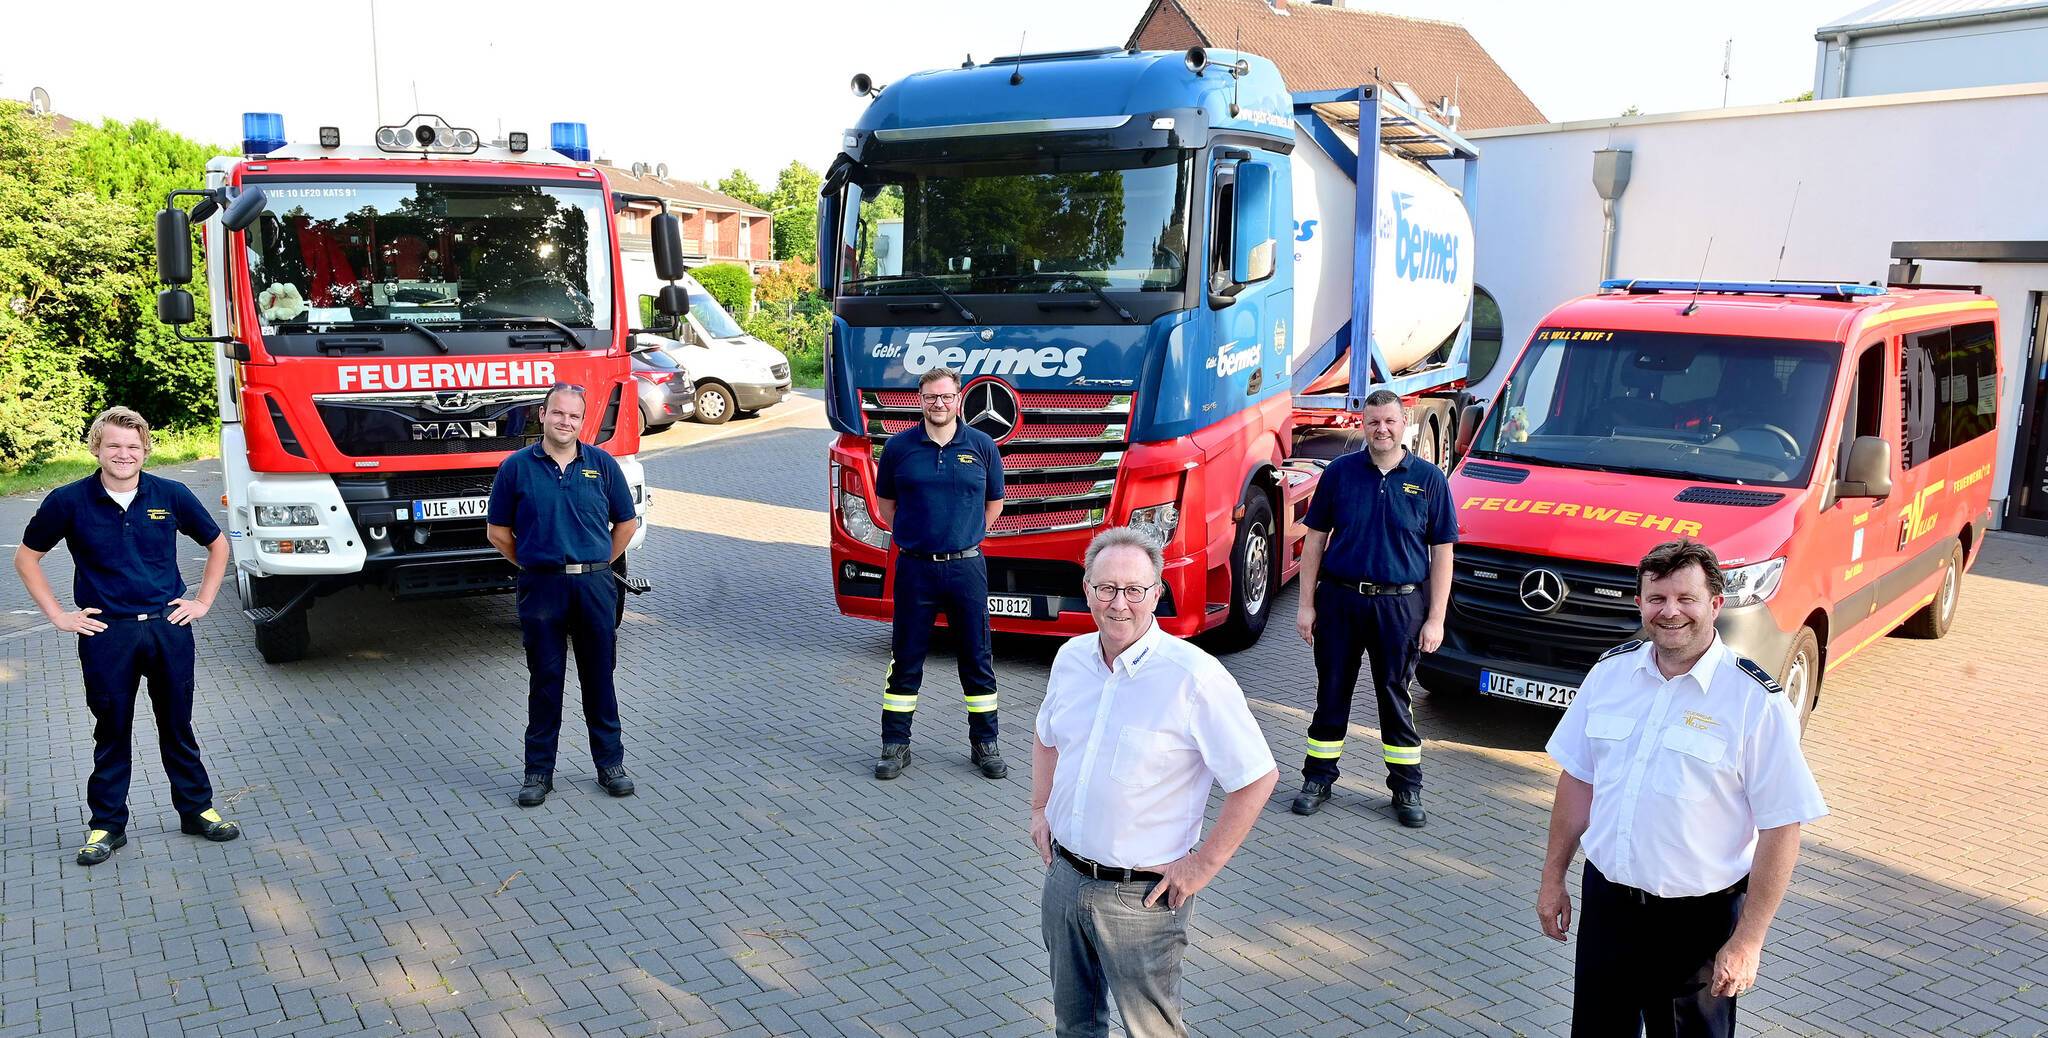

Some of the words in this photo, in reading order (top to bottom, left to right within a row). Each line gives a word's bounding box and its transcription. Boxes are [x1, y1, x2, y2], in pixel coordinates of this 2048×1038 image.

[270, 189, 284, 198] VIE
[287, 189, 298, 198] 10
[300, 188, 321, 197] LF20
[323, 188, 345, 198] KATS
[1391, 190, 1459, 285] bermes
[1550, 331, 1571, 340] WLL
[1571, 331, 1581, 340] 2
[1580, 331, 1605, 341] MTF
[1605, 332, 1614, 341] 1
[872, 343, 901, 358] Gebr.
[902, 332, 1088, 378] bermes
[1217, 341, 1262, 378] bermes
[337, 361, 556, 391] FEUERWEHR
[412, 421, 497, 440] MAN
[423, 502, 449, 517] VIE
[458, 500, 476, 515] KV
[1460, 496, 1704, 538] FEUERWEHR
[989, 598, 1004, 613] SD
[1006, 599, 1029, 614] 812
[1490, 674, 1515, 695] VIE
[1525, 682, 1546, 701] FW
